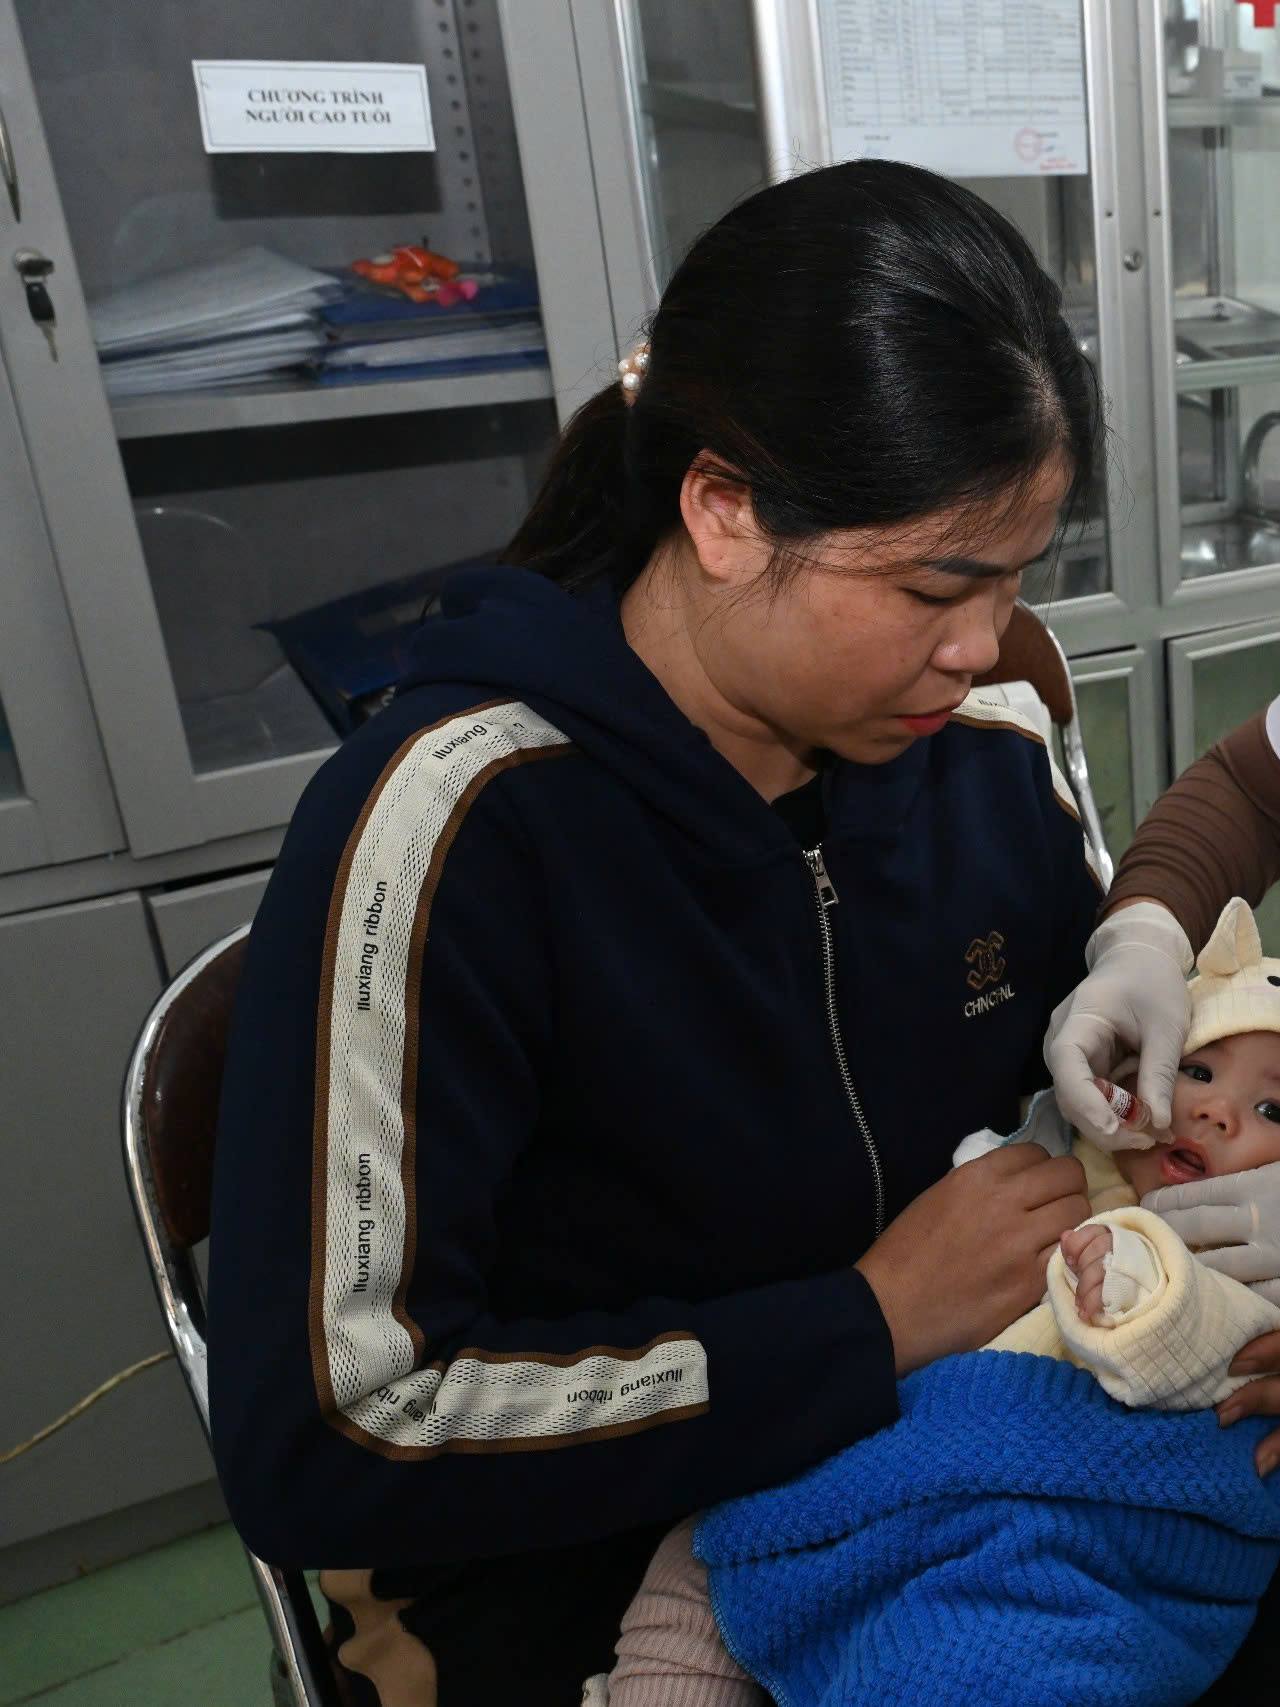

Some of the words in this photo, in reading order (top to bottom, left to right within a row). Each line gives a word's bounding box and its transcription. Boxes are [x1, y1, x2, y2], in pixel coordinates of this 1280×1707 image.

[247, 89, 325, 104] CHƯƠNG
[330, 88, 384, 104] TRÌNH
[245, 105, 305, 123] NGƯỜI
[309, 109, 346, 124] CAO
[350, 107, 393, 124] TUỔI
[362, 881, 388, 936] ribbon
[355, 1153, 372, 1211] ribbon
[567, 1388, 613, 1405] ribbon
